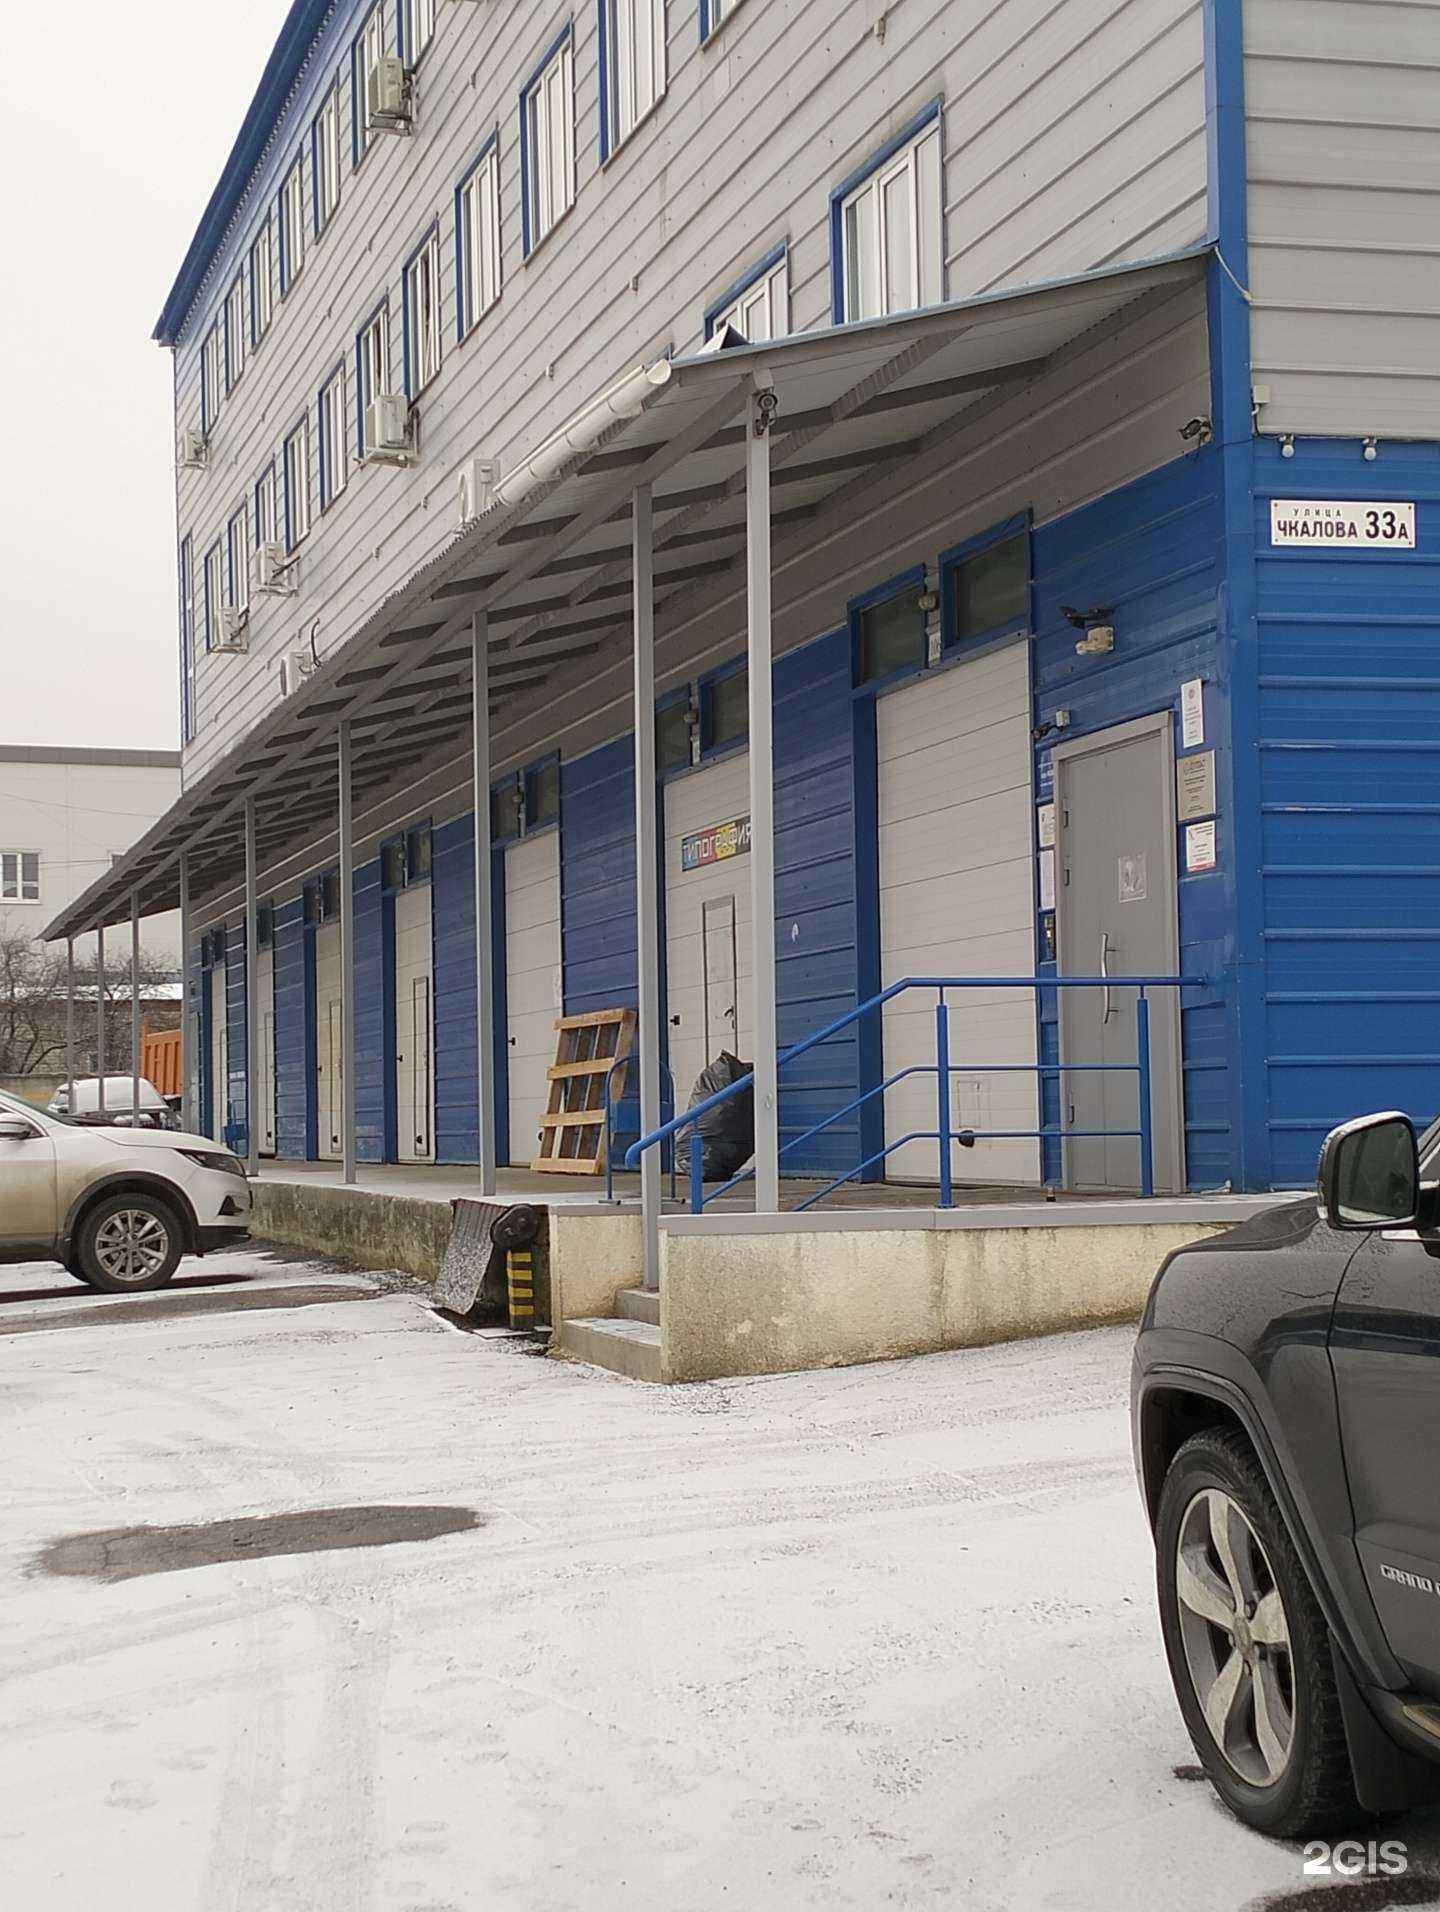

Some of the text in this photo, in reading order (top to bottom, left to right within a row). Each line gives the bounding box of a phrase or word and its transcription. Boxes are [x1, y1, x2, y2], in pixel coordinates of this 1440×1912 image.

[1294, 509, 1341, 517] УЛИЦА
[1277, 520, 1358, 538] ЧКАЛОВА
[1380, 1564, 1432, 1593] GRAND
